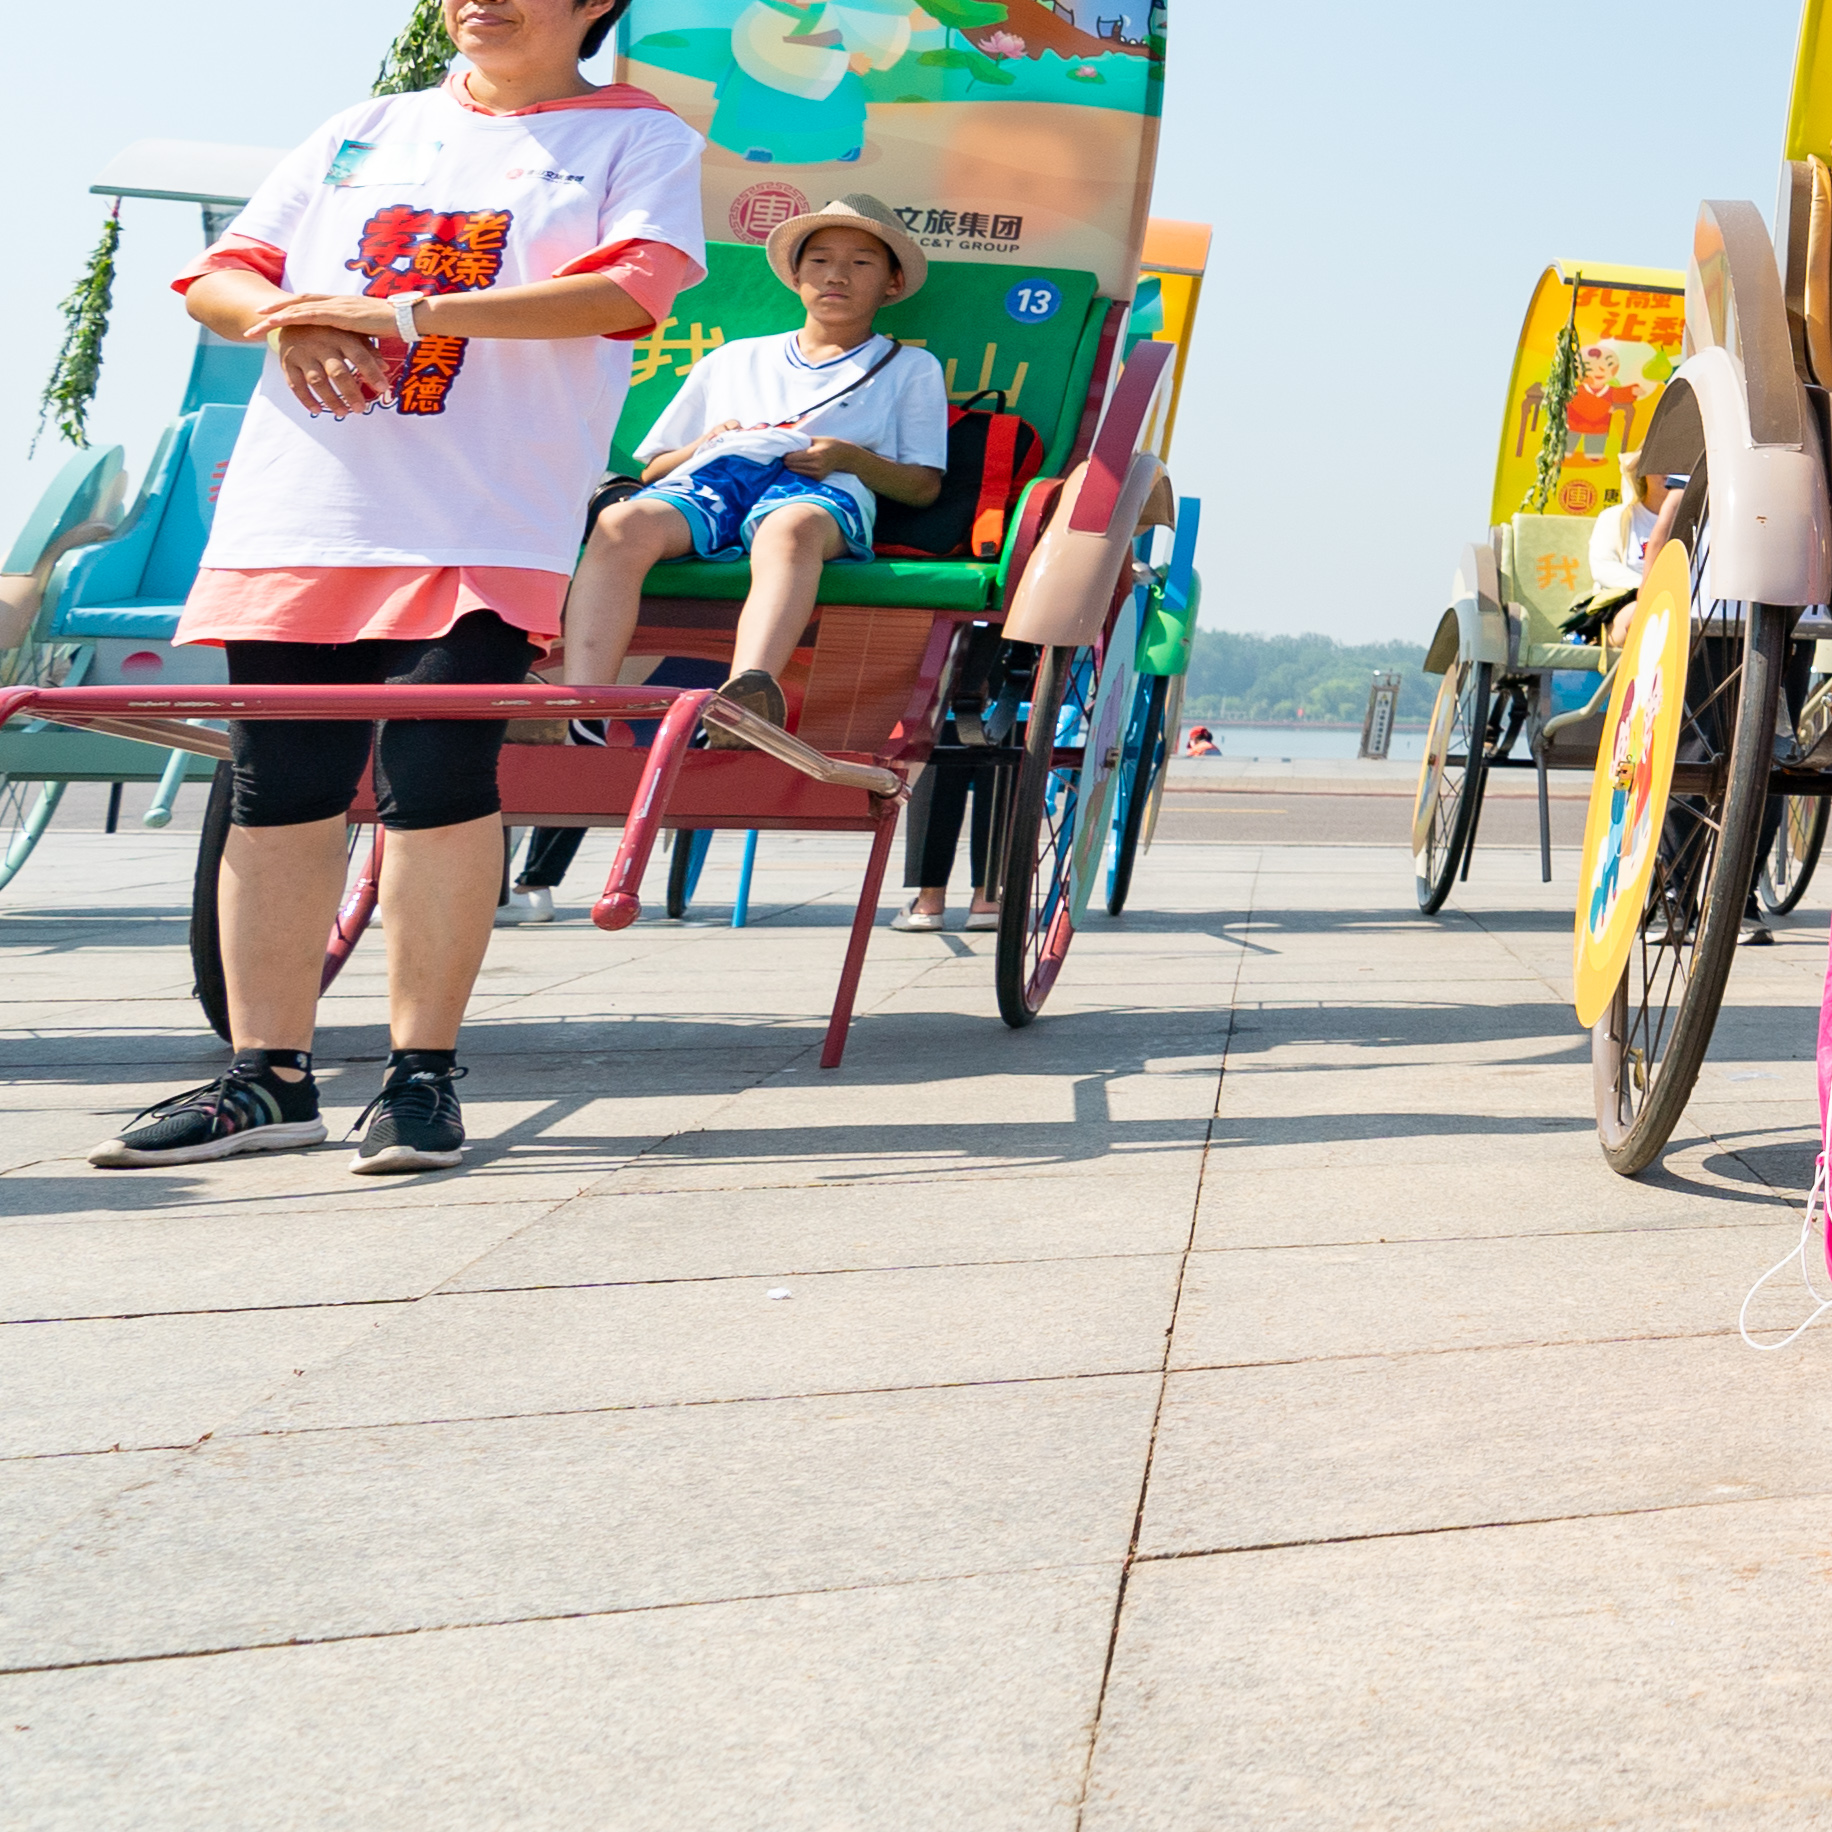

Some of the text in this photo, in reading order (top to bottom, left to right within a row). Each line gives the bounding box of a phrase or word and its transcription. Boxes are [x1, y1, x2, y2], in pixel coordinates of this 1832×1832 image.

[893, 206, 1023, 241] 文旅集团
[959, 241, 1020, 254] GROUP
[1017, 288, 1052, 315] 13
[1536, 552, 1581, 591] 我
